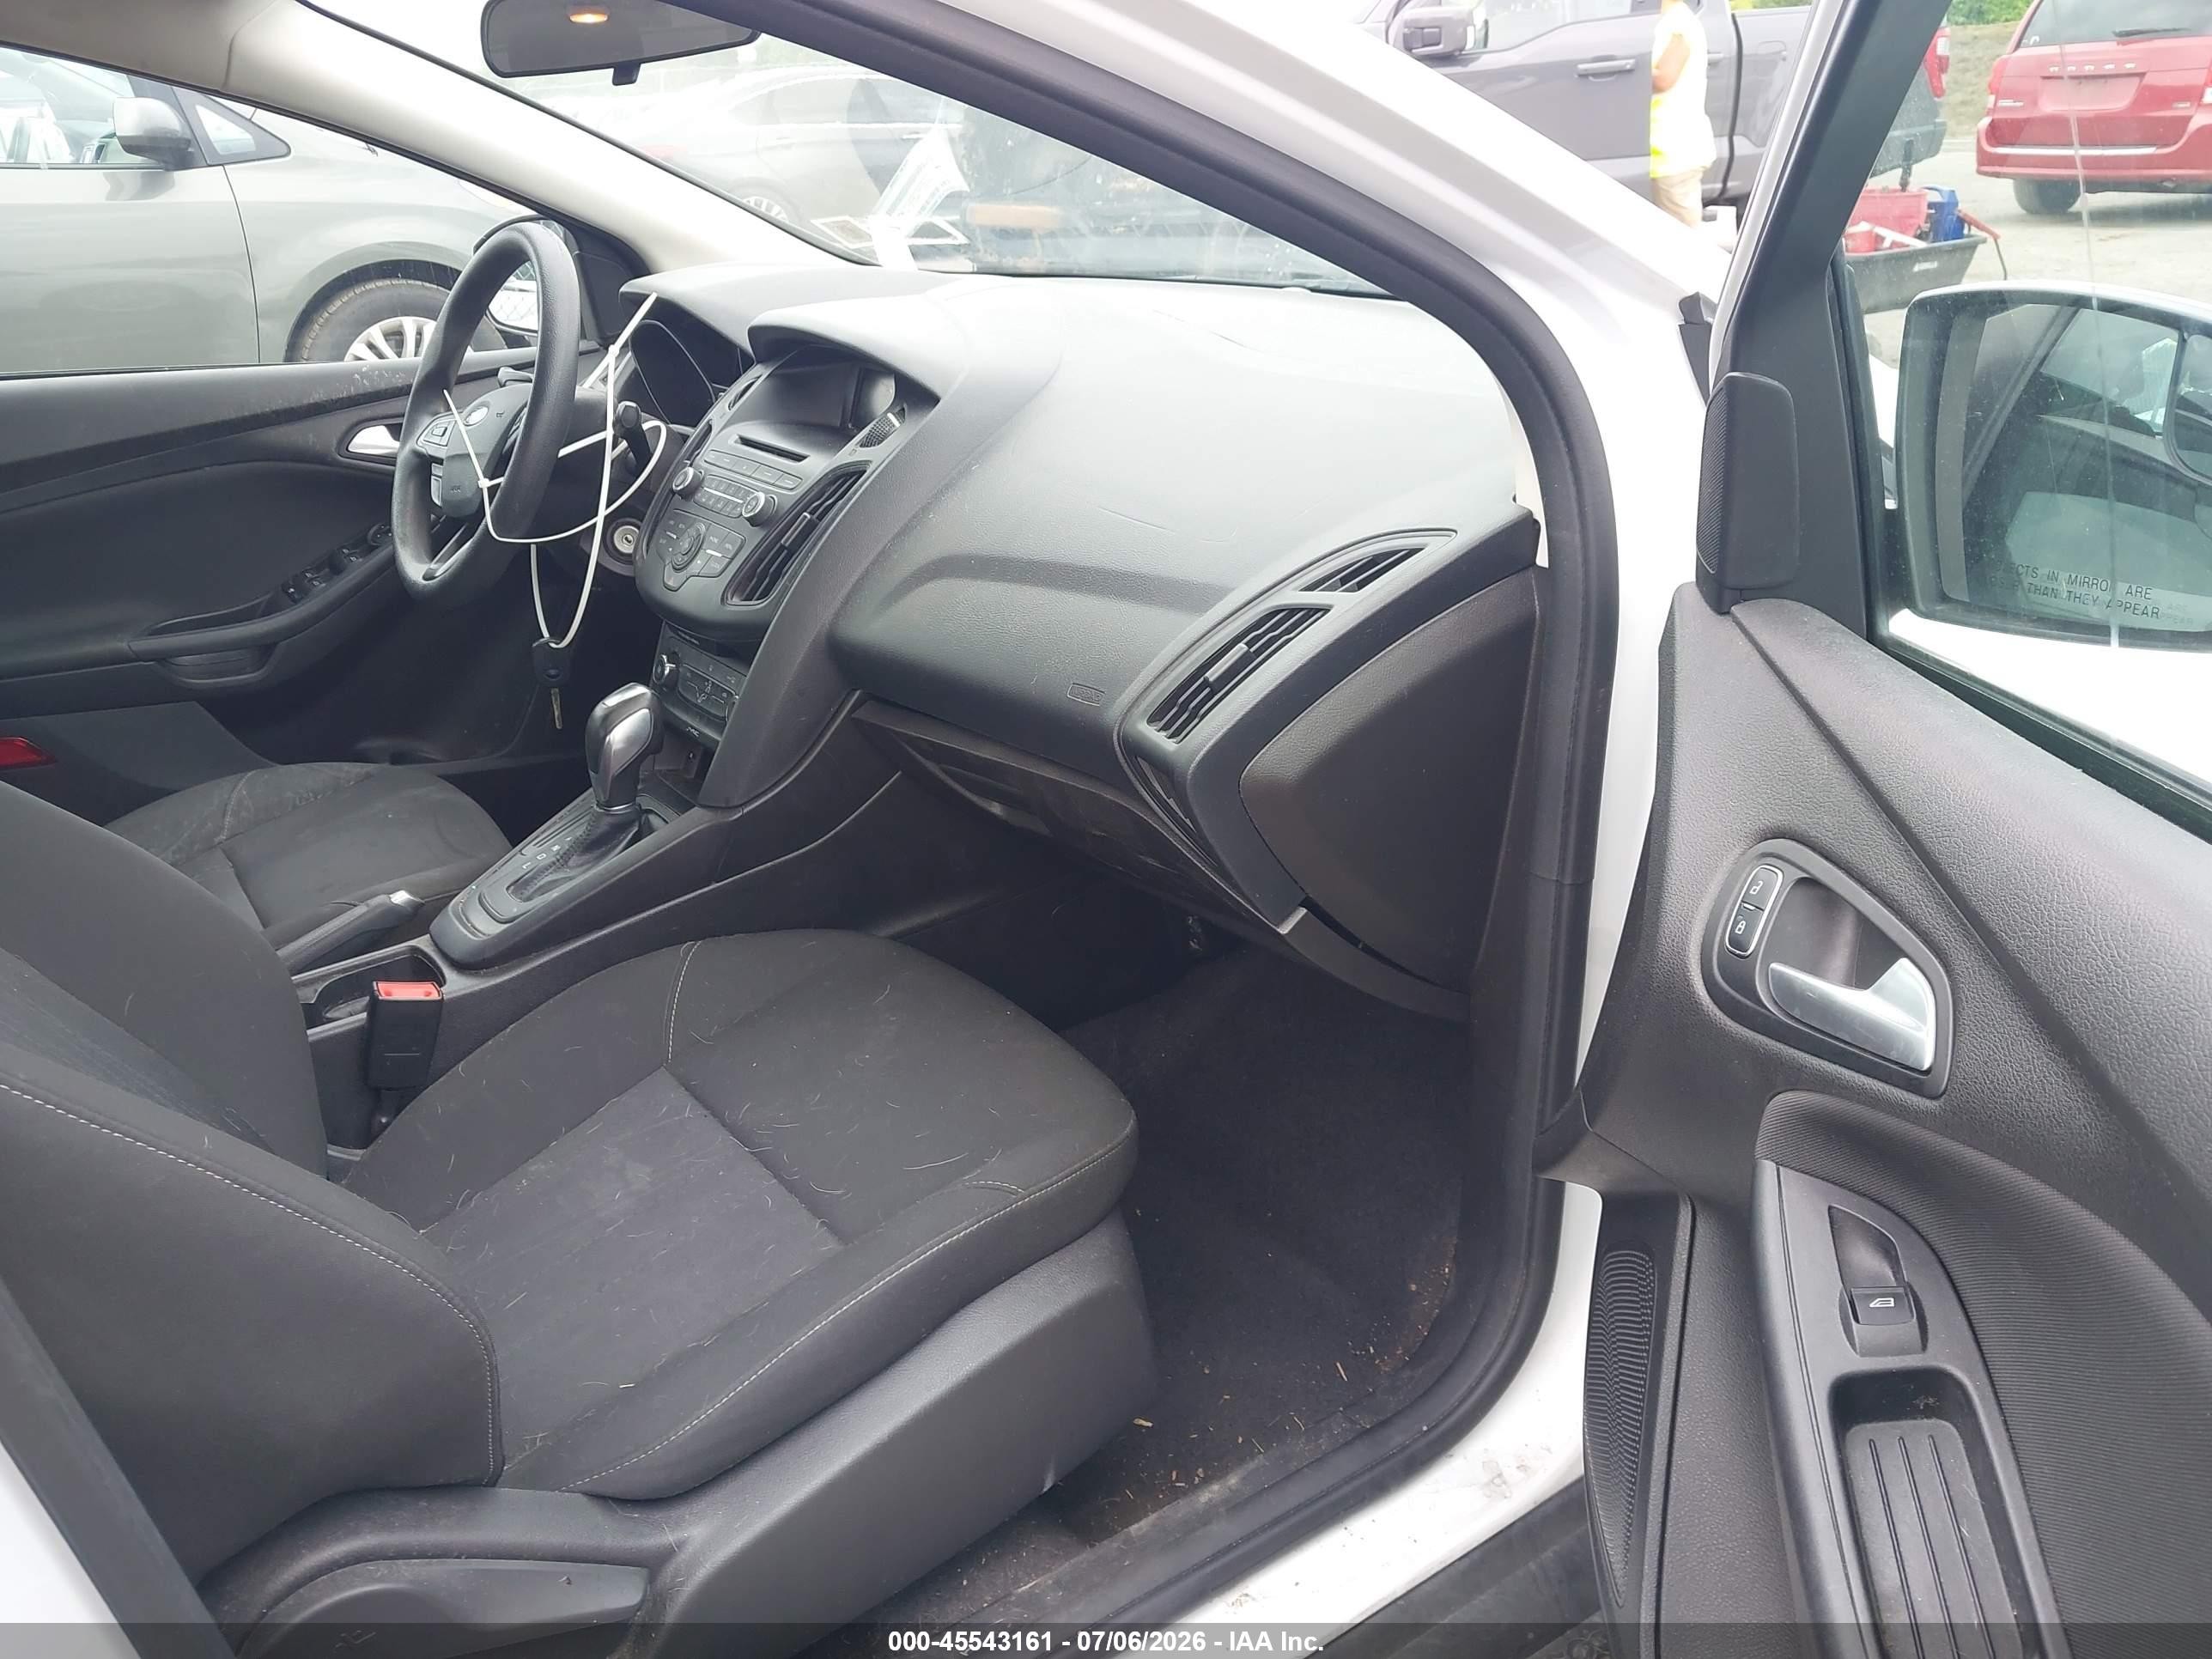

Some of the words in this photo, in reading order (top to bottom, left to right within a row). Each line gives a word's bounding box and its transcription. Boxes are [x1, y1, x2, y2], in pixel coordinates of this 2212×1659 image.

[2027, 582, 2058, 599] THAN
[2066, 590, 2100, 607] THEY
[2046, 569, 2060, 584] IN
[2067, 573, 2113, 592] MIRRO
[2124, 585, 2153, 600] ARE
